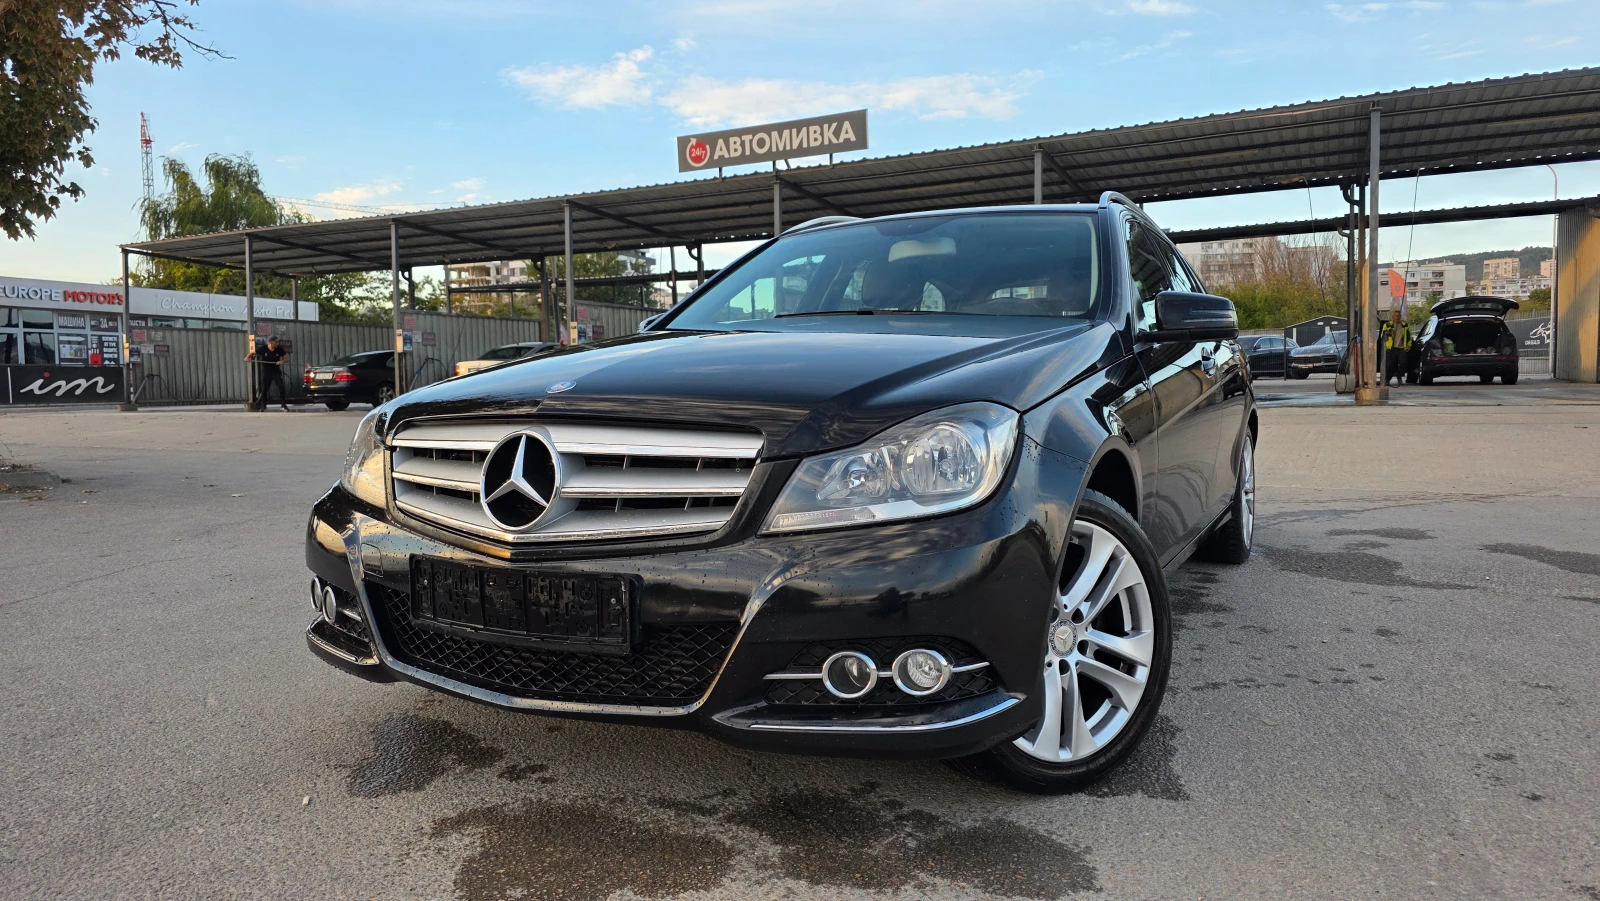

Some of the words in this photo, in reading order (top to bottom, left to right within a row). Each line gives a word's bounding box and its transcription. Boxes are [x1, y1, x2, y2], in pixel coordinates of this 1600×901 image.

[691, 147, 706, 159] 24/7
[713, 120, 856, 160] АВТОМИВКА
[161, 297, 237, 314] Champion
[59, 315, 85, 327] МАШИНА
